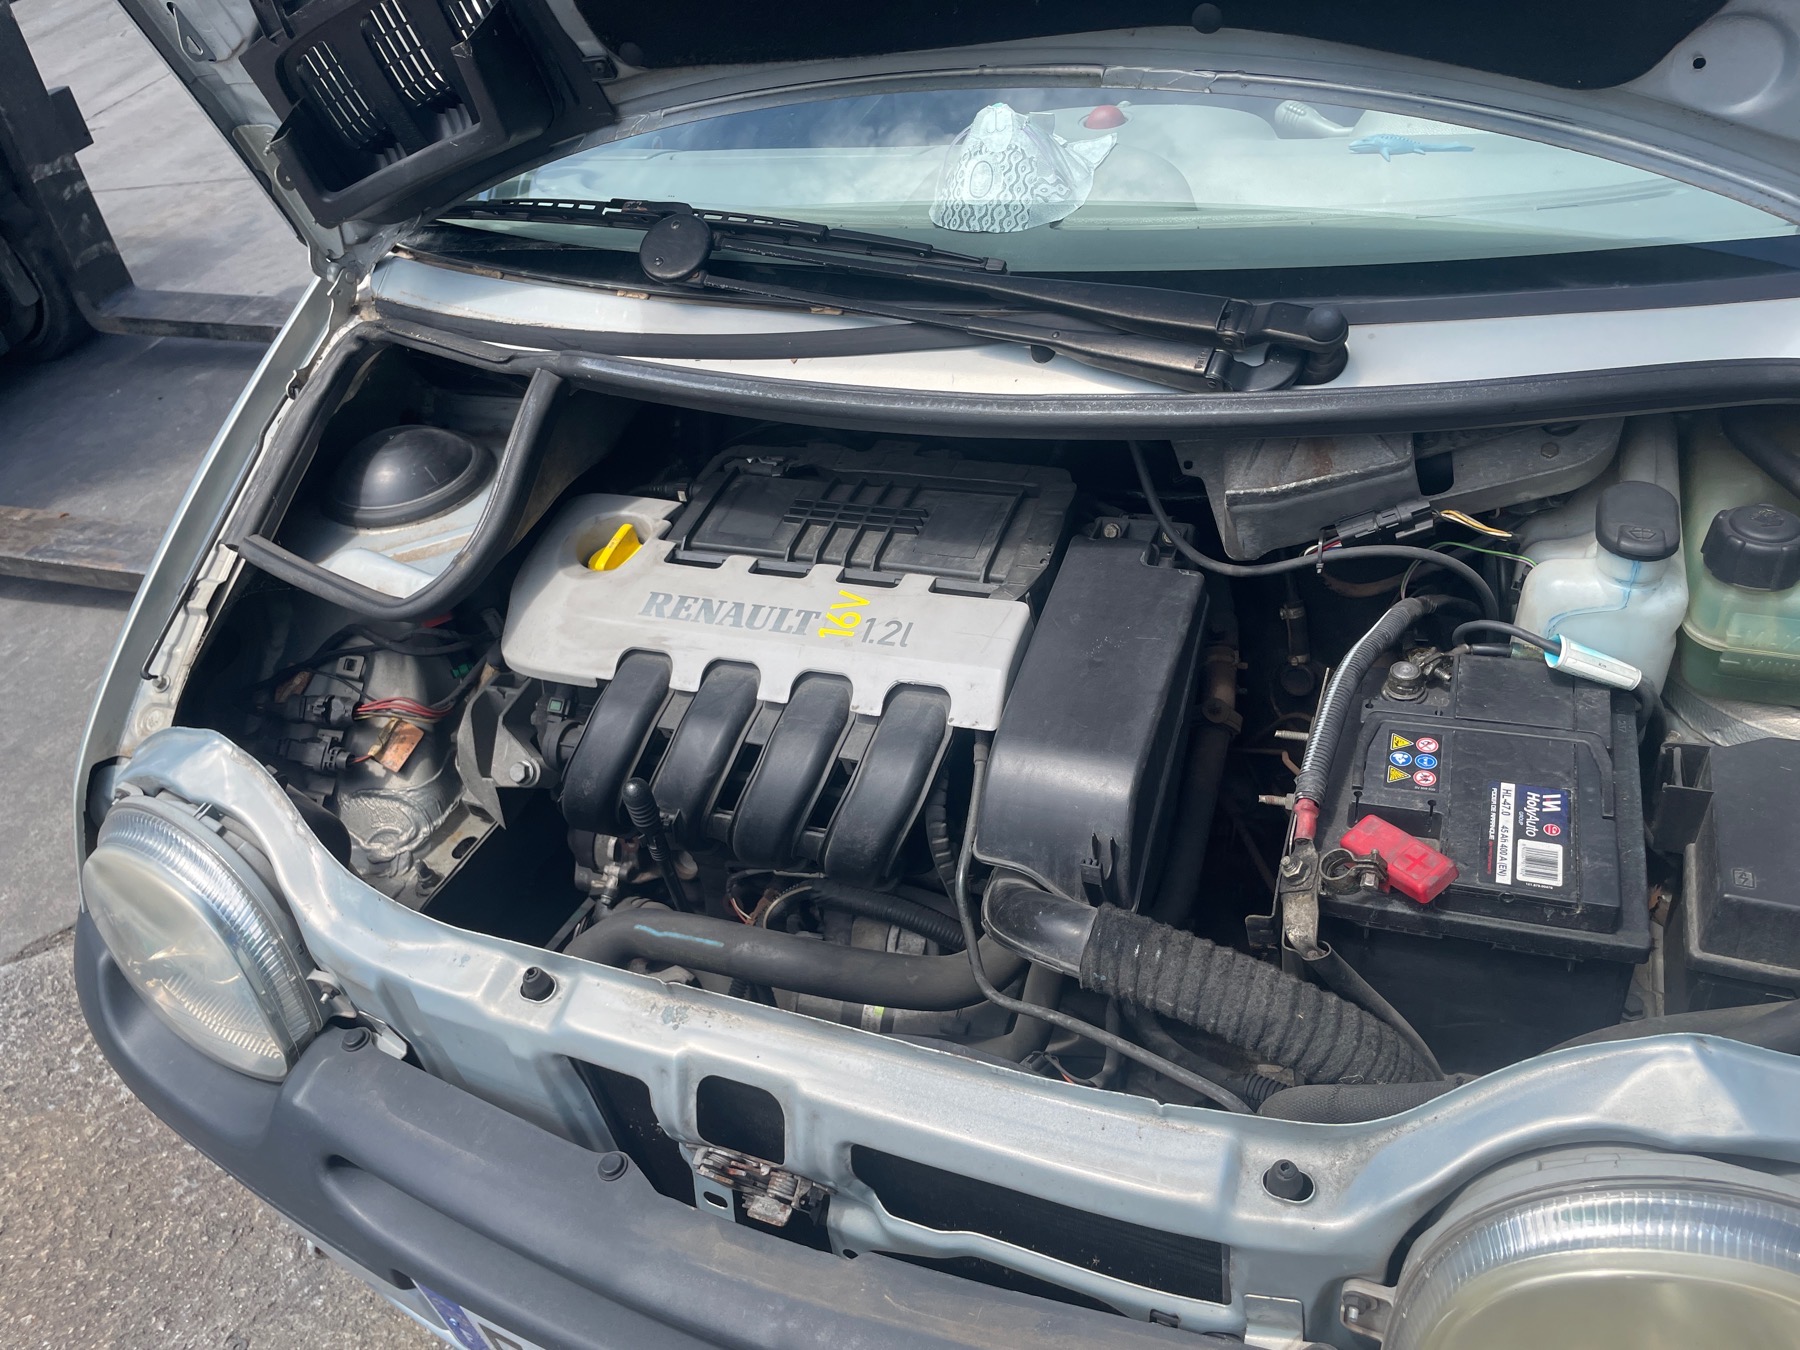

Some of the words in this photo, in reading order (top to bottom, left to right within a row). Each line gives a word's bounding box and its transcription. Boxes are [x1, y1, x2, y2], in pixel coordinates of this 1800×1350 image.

[638, 591, 822, 636] RENAULT
[818, 589, 871, 638] 16V
[1501, 788, 1512, 816] HL-47.0
[1523, 792, 1540, 837] HolyAuto
[1501, 825, 1509, 833] 45
[1499, 843, 1508, 855] 400
[1497, 862, 1507, 877] (EN)
